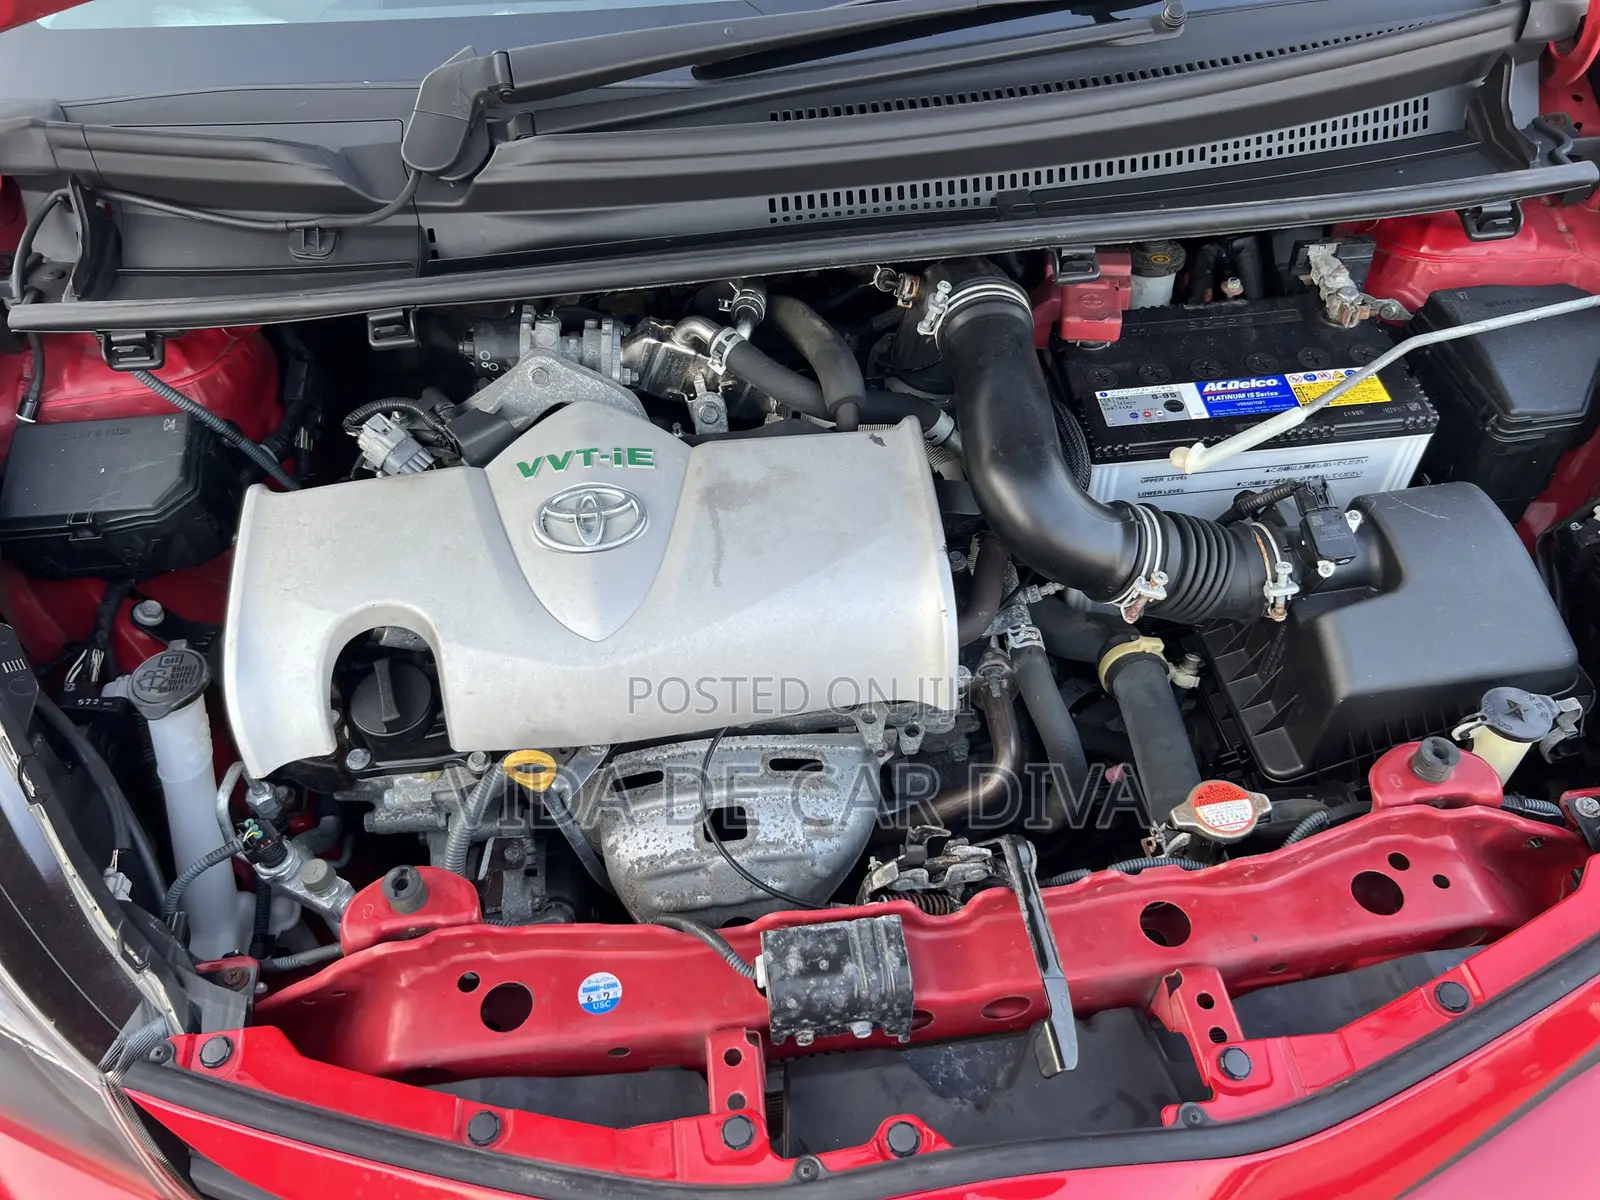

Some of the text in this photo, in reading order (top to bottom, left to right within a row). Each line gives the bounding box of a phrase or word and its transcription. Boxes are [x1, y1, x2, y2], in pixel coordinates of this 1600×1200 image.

[1203, 378, 1278, 392] ACDelco
[1207, 393, 1246, 402] PLATINUM
[105, 426, 132, 436] FUSE
[516, 447, 656, 482] VVT-iE
[1137, 489, 1162, 497] LOWER
[593, 999, 611, 1010] USC
